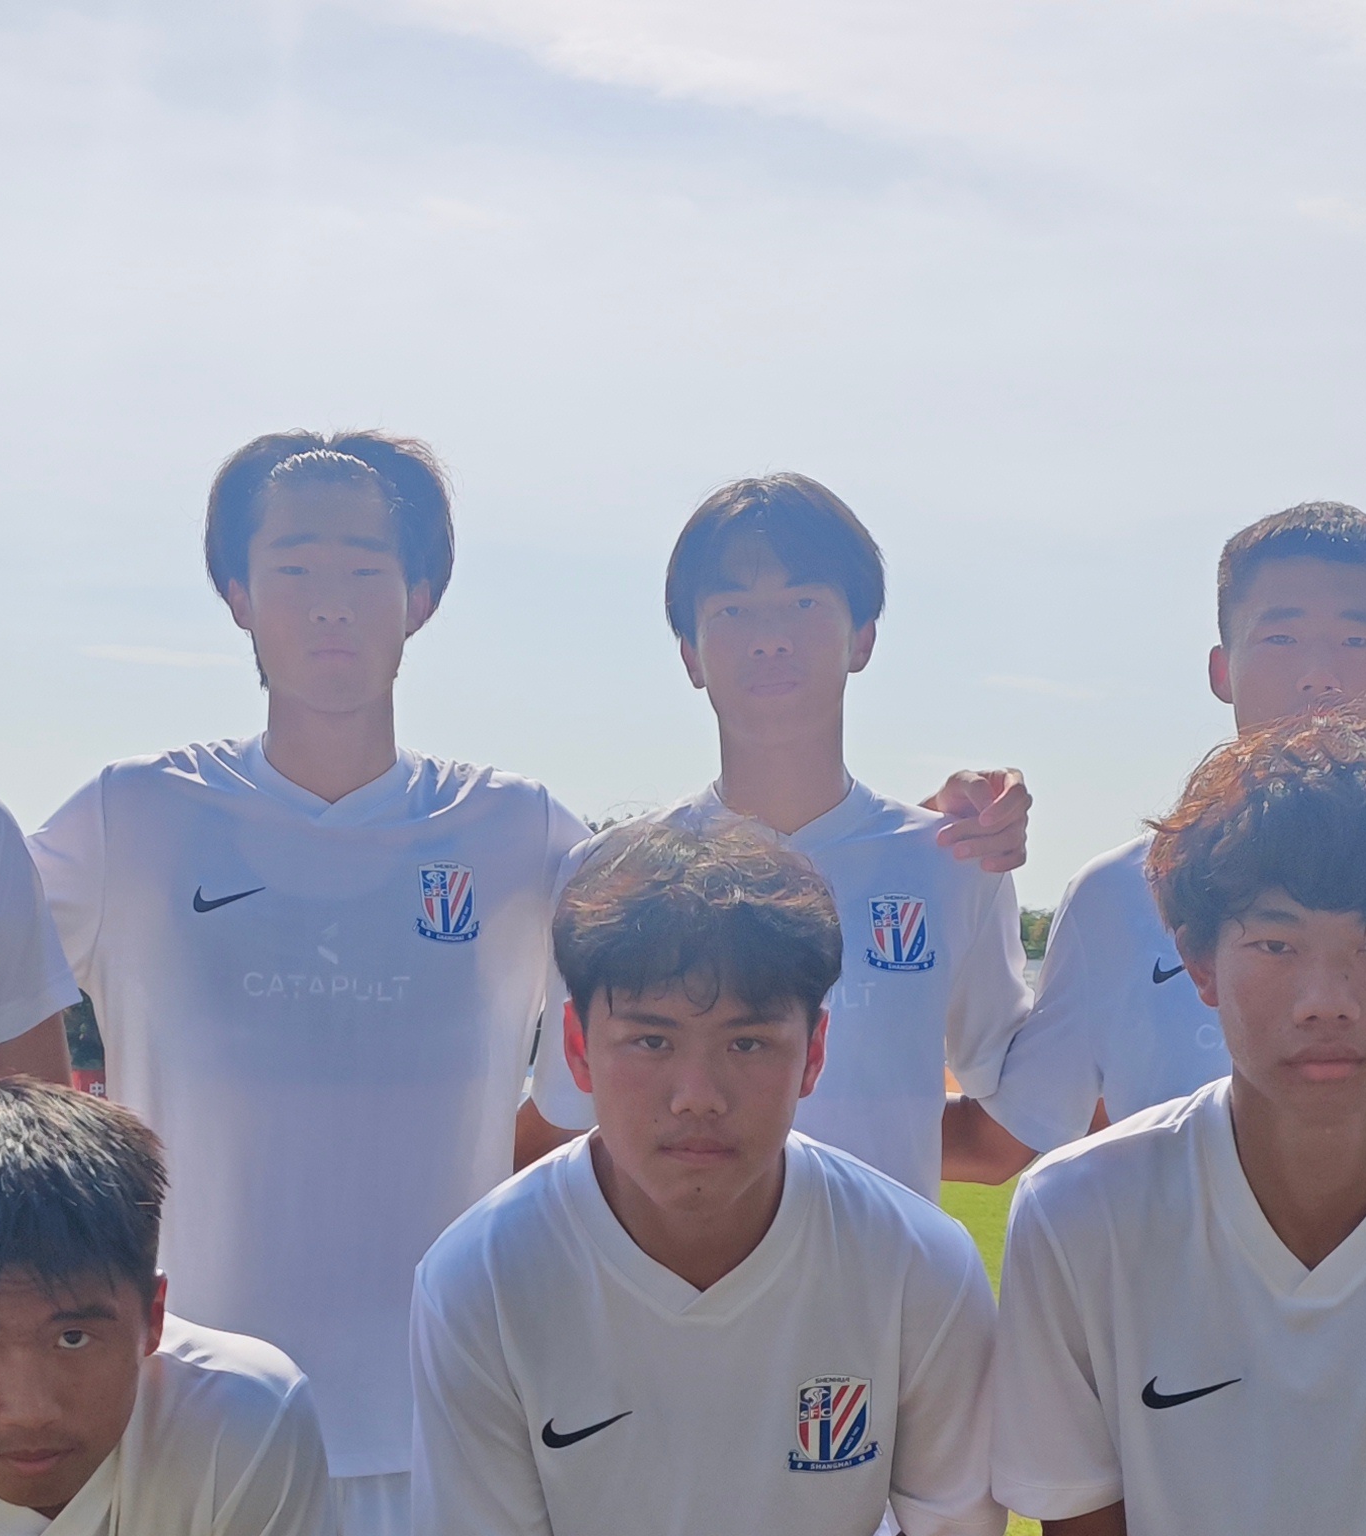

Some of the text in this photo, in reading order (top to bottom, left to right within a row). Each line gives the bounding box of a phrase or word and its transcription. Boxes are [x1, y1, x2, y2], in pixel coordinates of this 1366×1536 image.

[243, 970, 411, 1002] CATAPULT
[800, 1407, 832, 1421] SFC
[810, 1459, 853, 1470] SHANGHAI
